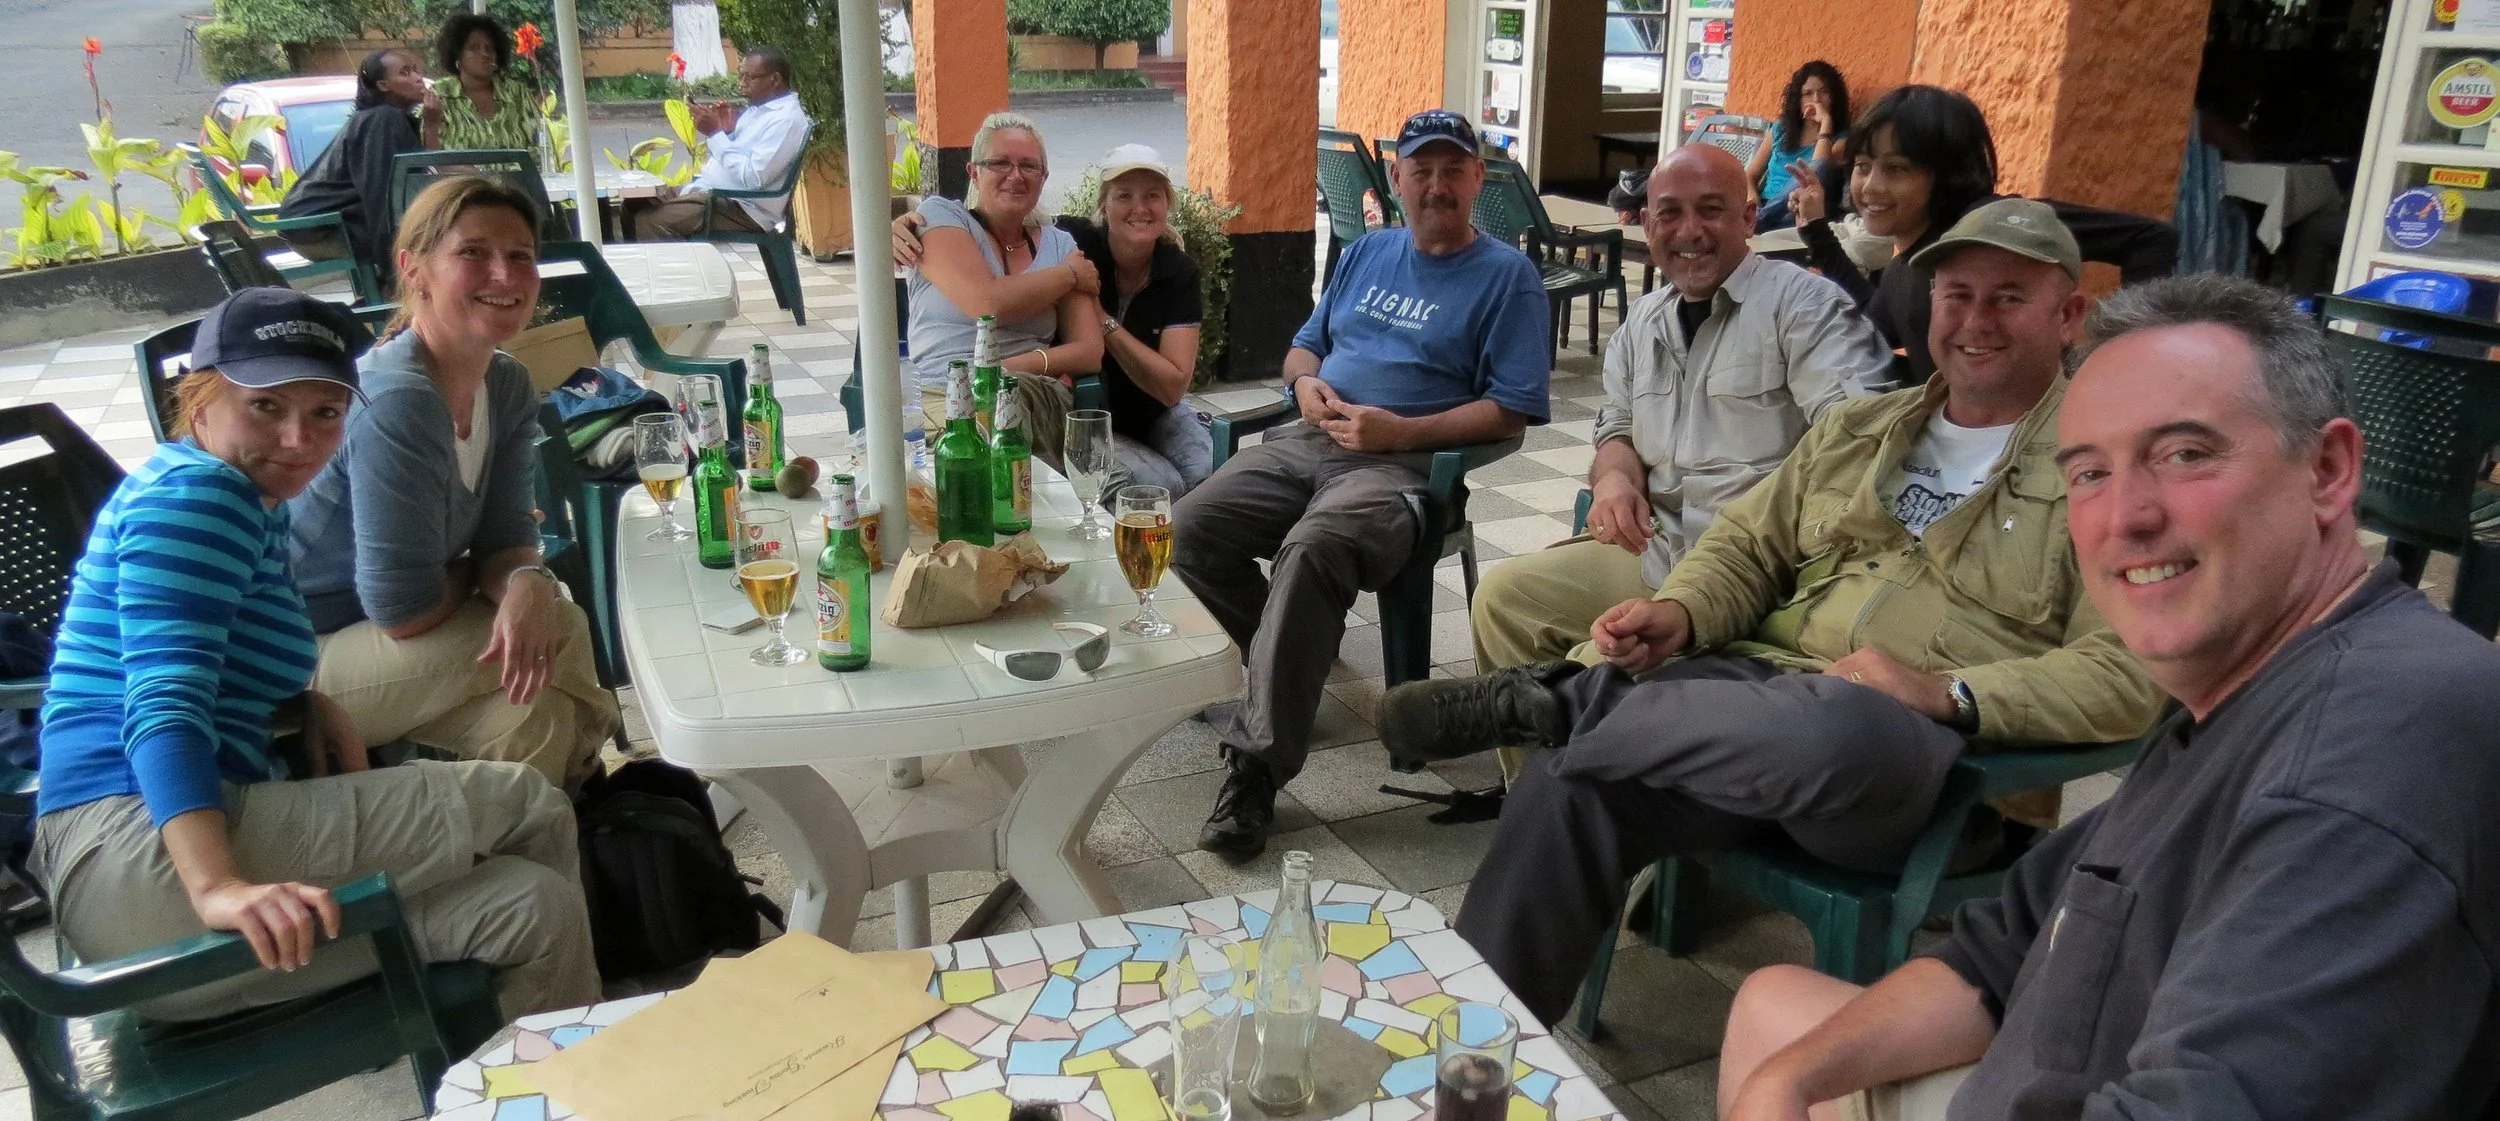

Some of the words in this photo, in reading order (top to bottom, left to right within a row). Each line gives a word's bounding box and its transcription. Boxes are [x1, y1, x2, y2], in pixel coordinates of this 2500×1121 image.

[2444, 83, 2492, 95] AMSTEL
[2451, 97, 2479, 106] BEER
[1485, 132, 1504, 147] 2012
